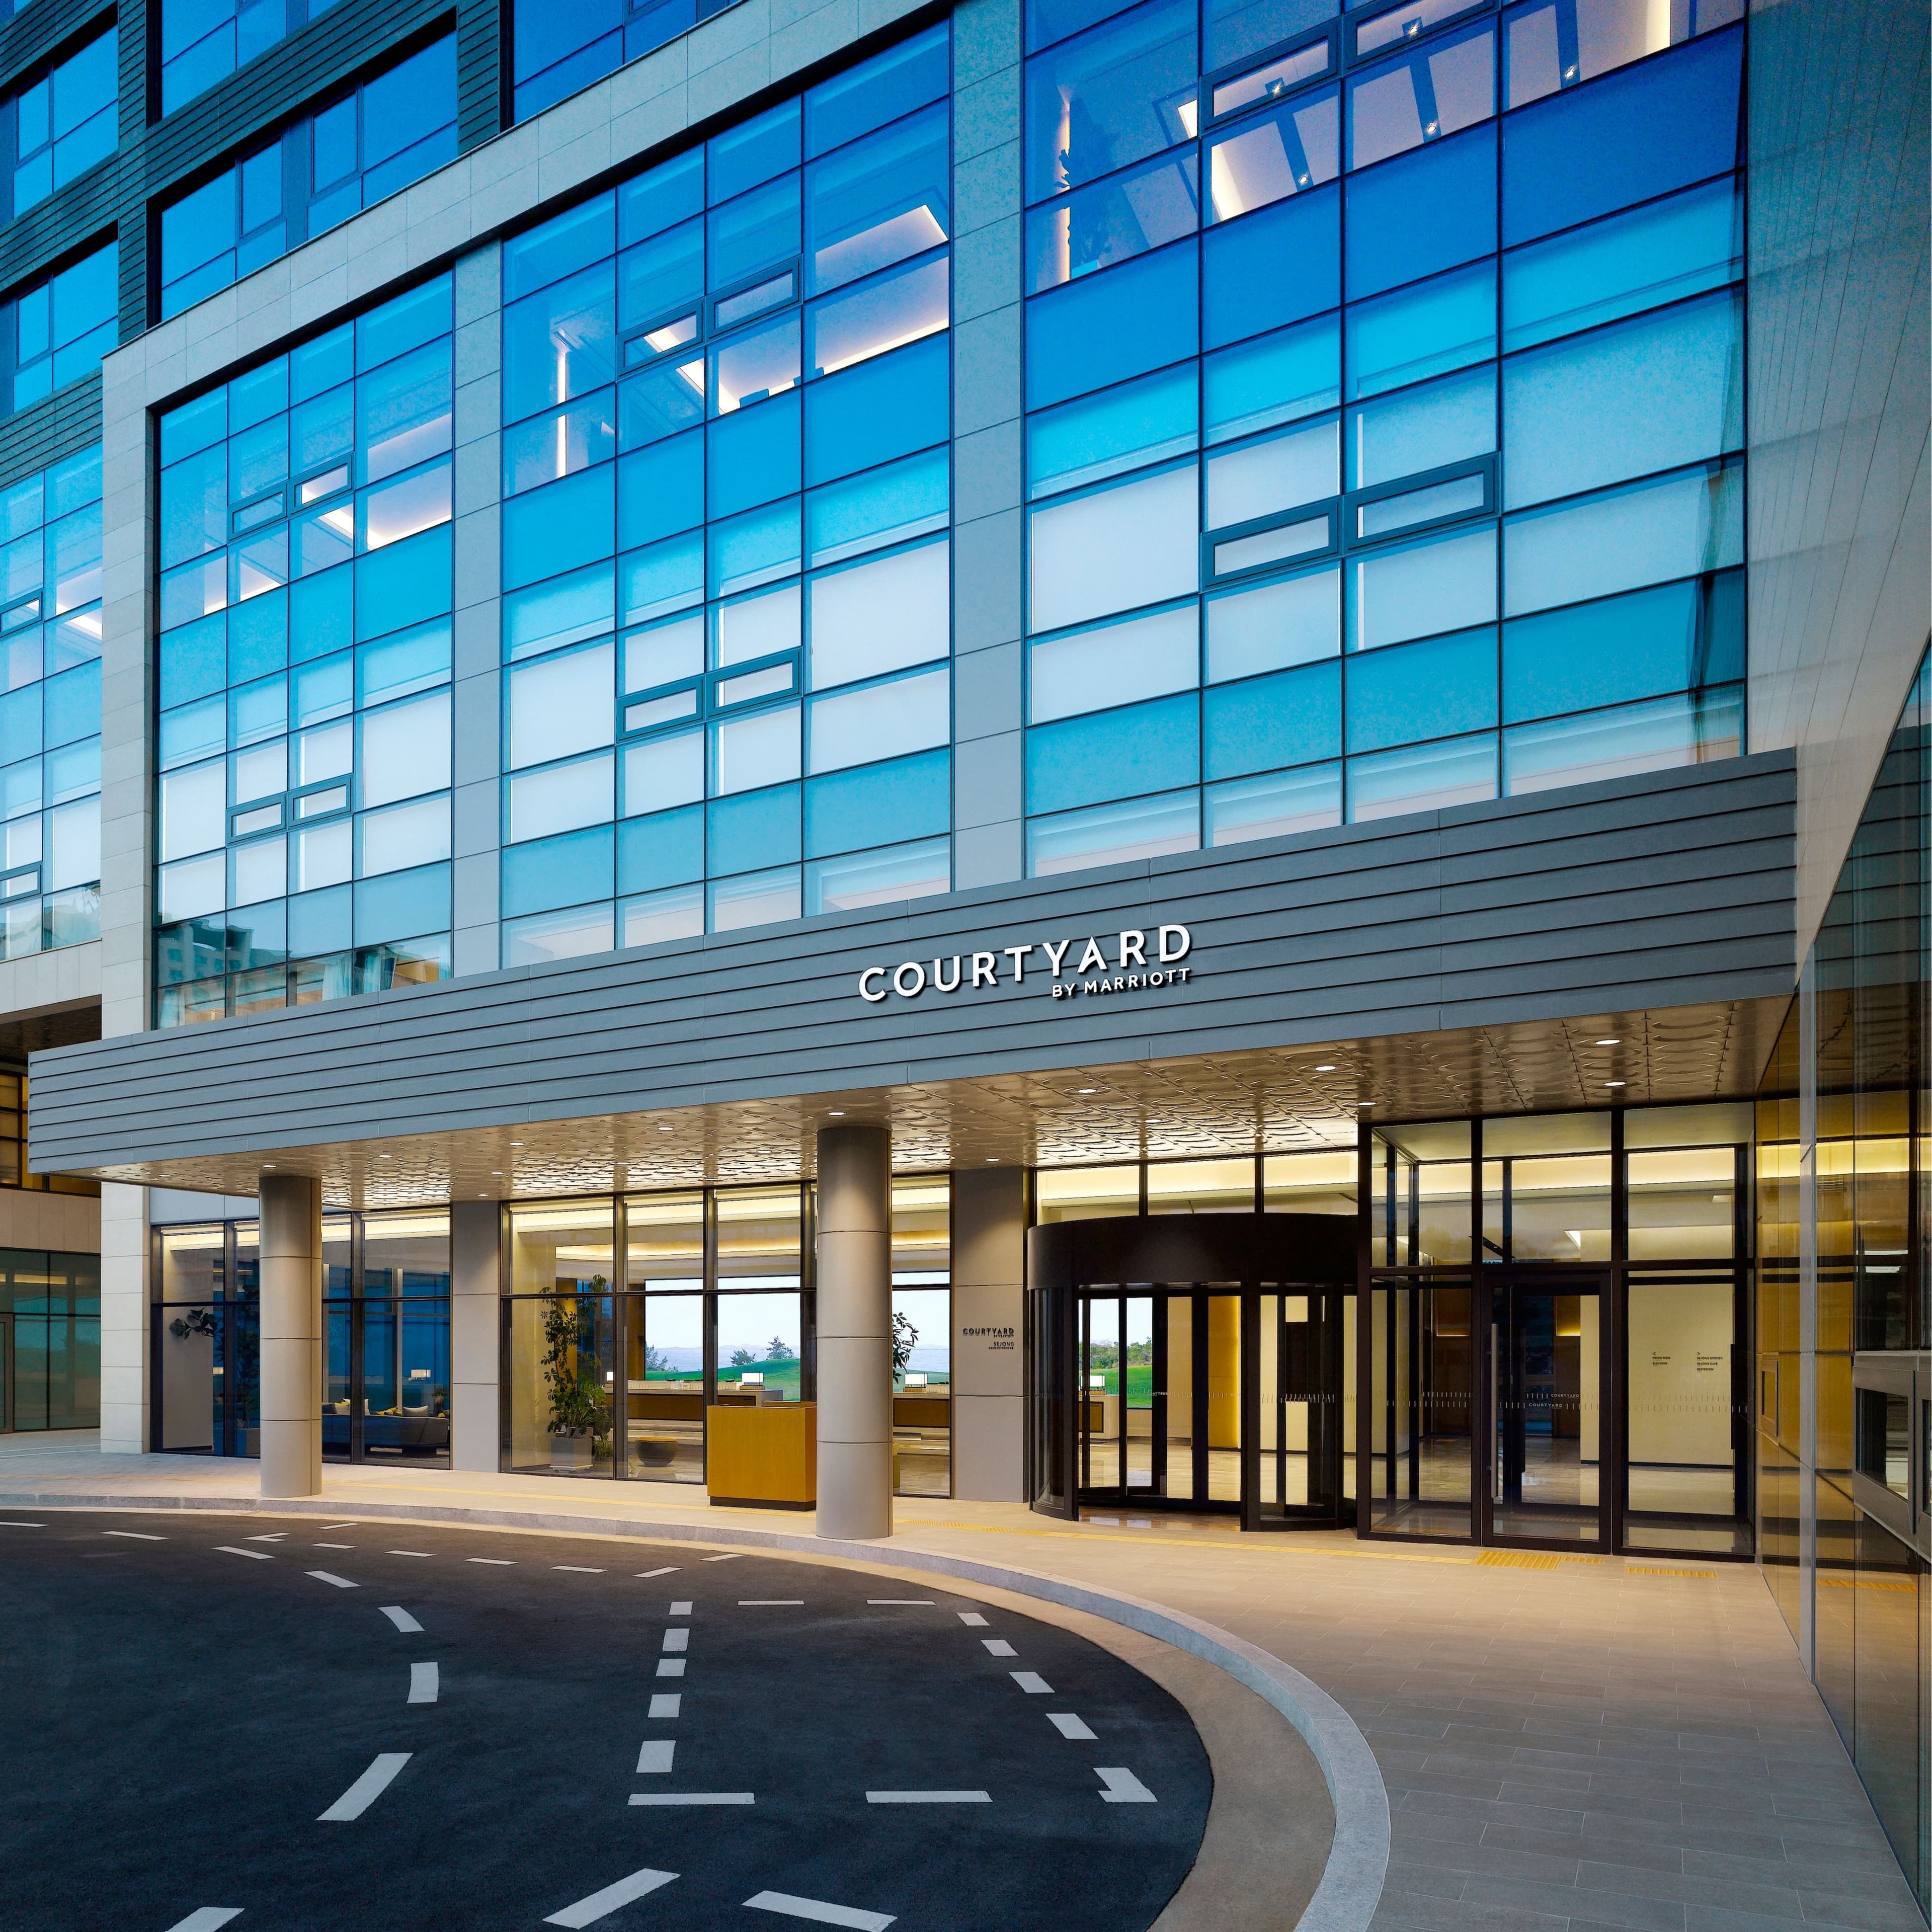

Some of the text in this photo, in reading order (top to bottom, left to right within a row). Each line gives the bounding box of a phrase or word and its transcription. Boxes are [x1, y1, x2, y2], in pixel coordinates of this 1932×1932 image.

[858, 924, 1190, 1002] COURTYARD
[1052, 968, 1190, 998] BY MARRIOTT
